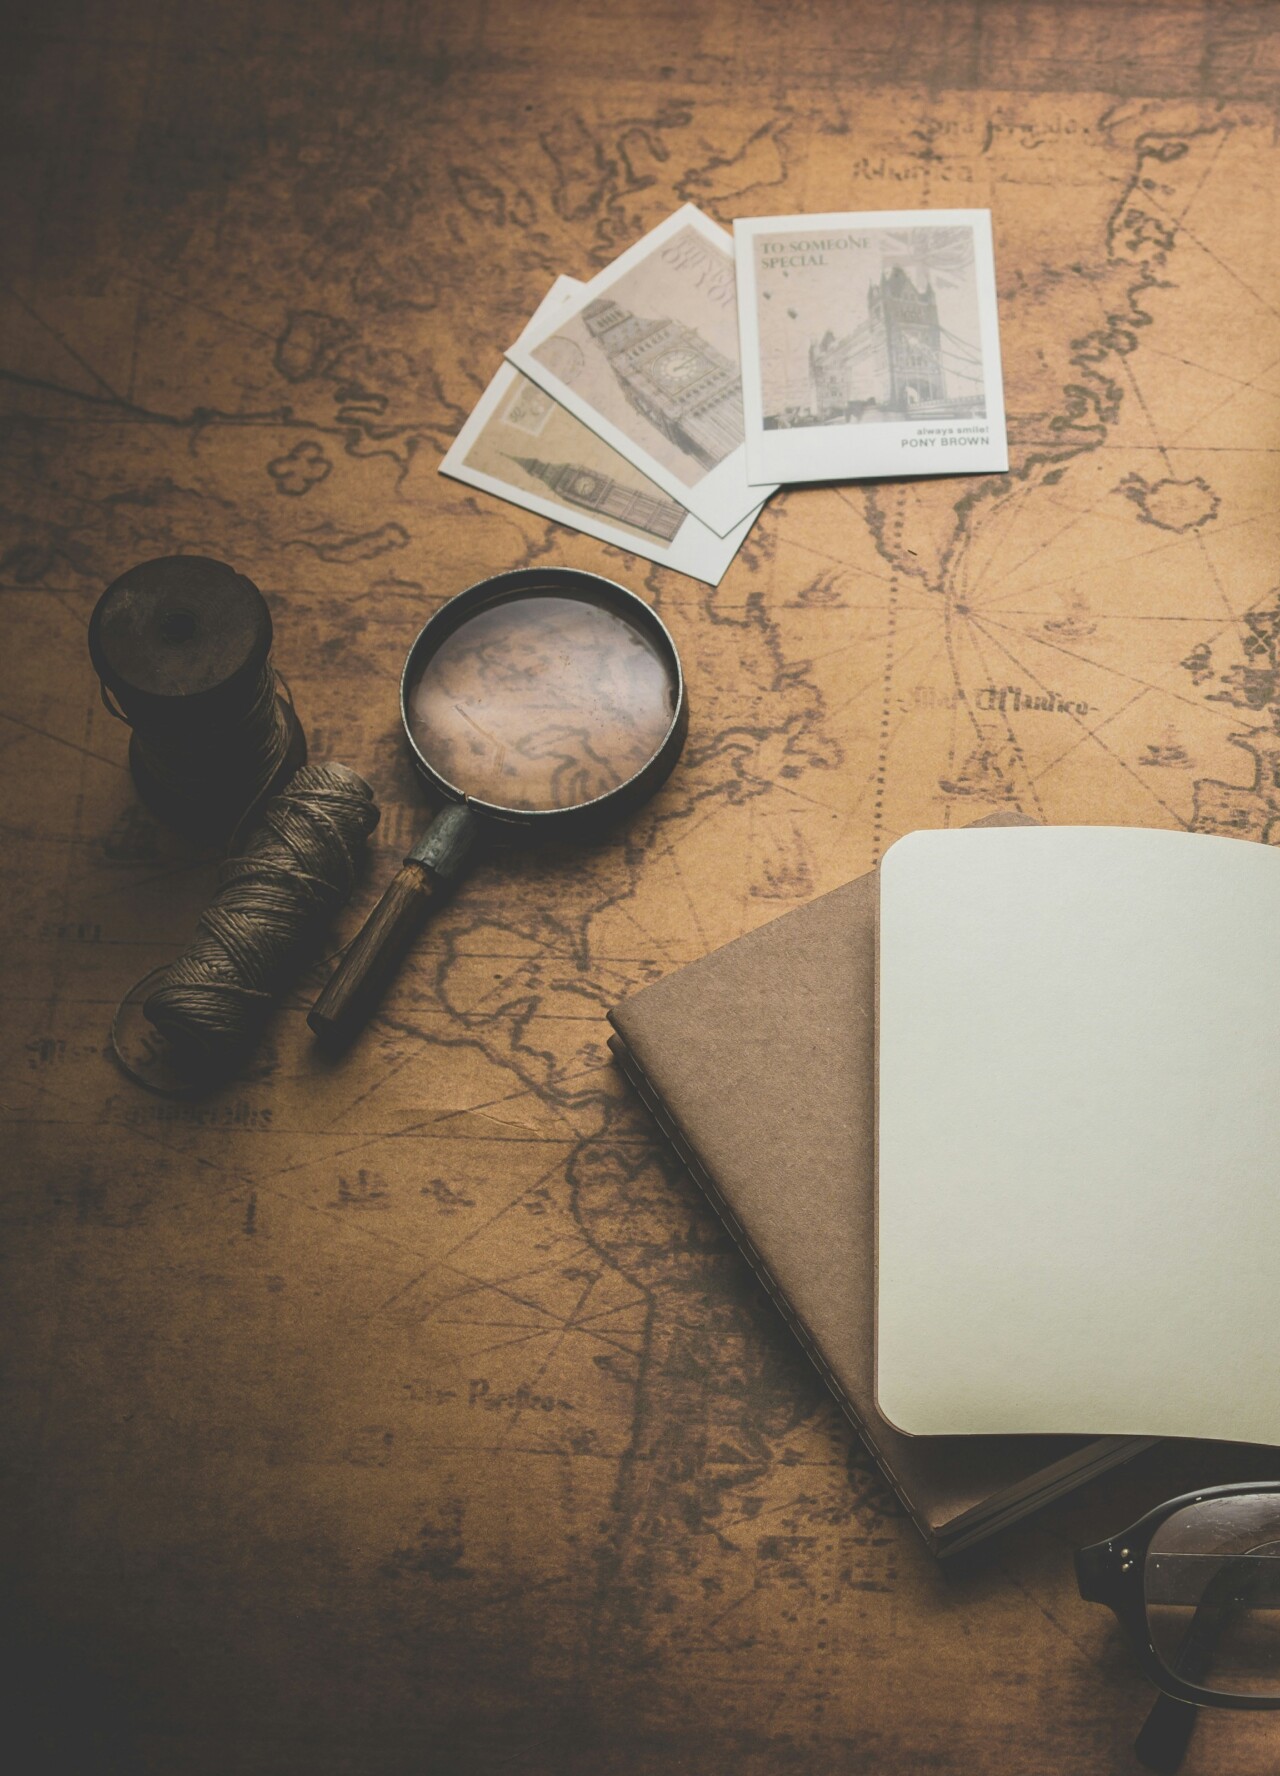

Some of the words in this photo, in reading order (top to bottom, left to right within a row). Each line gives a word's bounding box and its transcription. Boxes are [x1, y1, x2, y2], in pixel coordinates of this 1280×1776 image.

[760, 242, 785, 255] TO
[788, 234, 871, 253] SOMEONE
[761, 253, 828, 270] SPECIAL
[917, 427, 954, 437] always
[957, 424, 990, 435] smile!
[901, 437, 937, 449] PONY
[940, 435, 990, 447] BROWN
